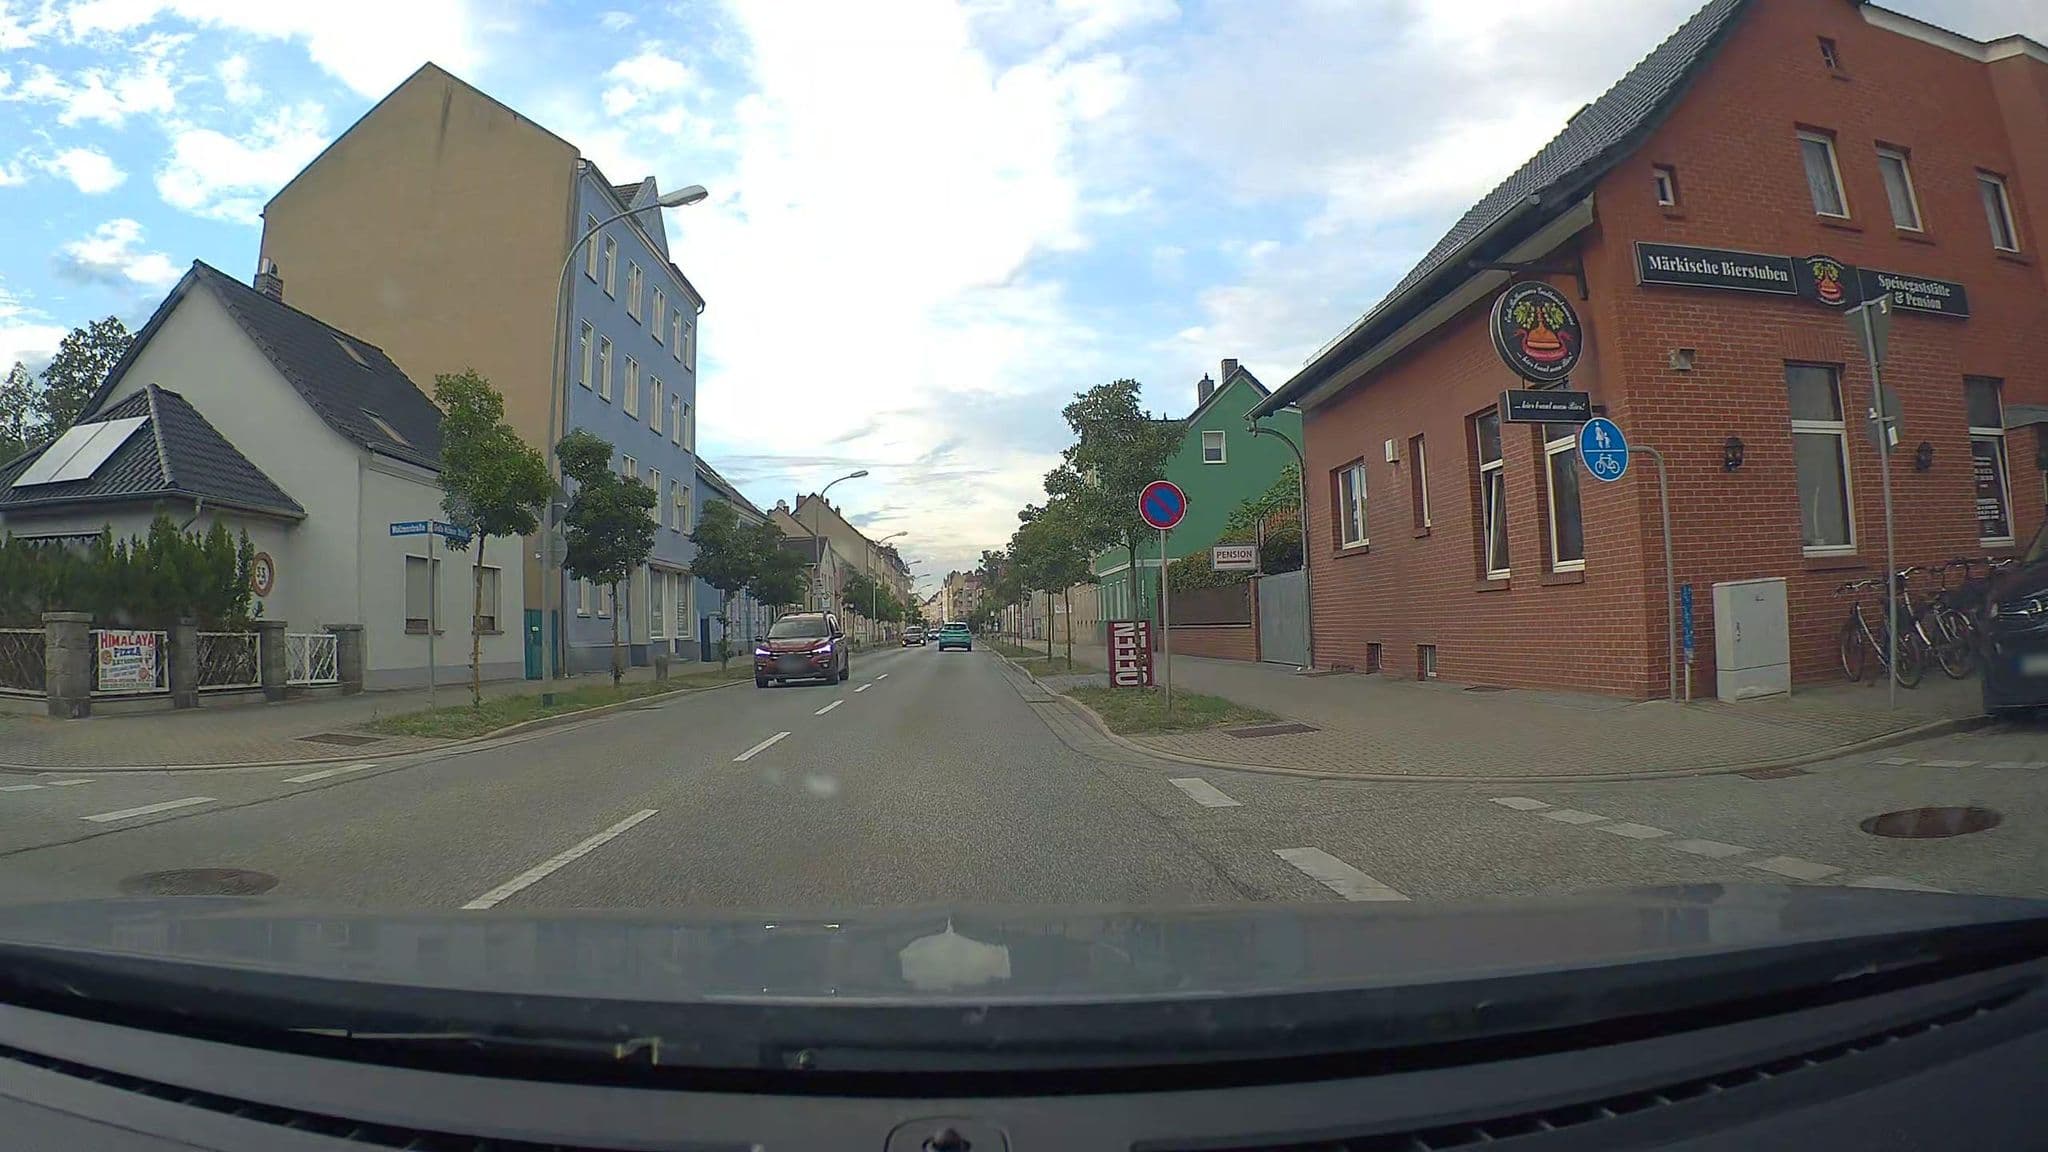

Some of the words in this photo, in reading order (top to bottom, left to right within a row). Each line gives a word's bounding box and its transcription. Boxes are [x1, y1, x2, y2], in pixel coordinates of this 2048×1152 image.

[1648, 255, 1719, 275] Märkische
[1721, 262, 1788, 282] Bierstuben
[1878, 274, 1950, 297] Speisegaststätte
[1895, 291, 1904, 304] &
[1906, 293, 1942, 310] Pension
[1216, 550, 1253, 560] PENSION
[100, 631, 155, 649] HIMALAYA
[113, 646, 142, 658] PIZZA
[1113, 622, 1148, 687] OFFEN
